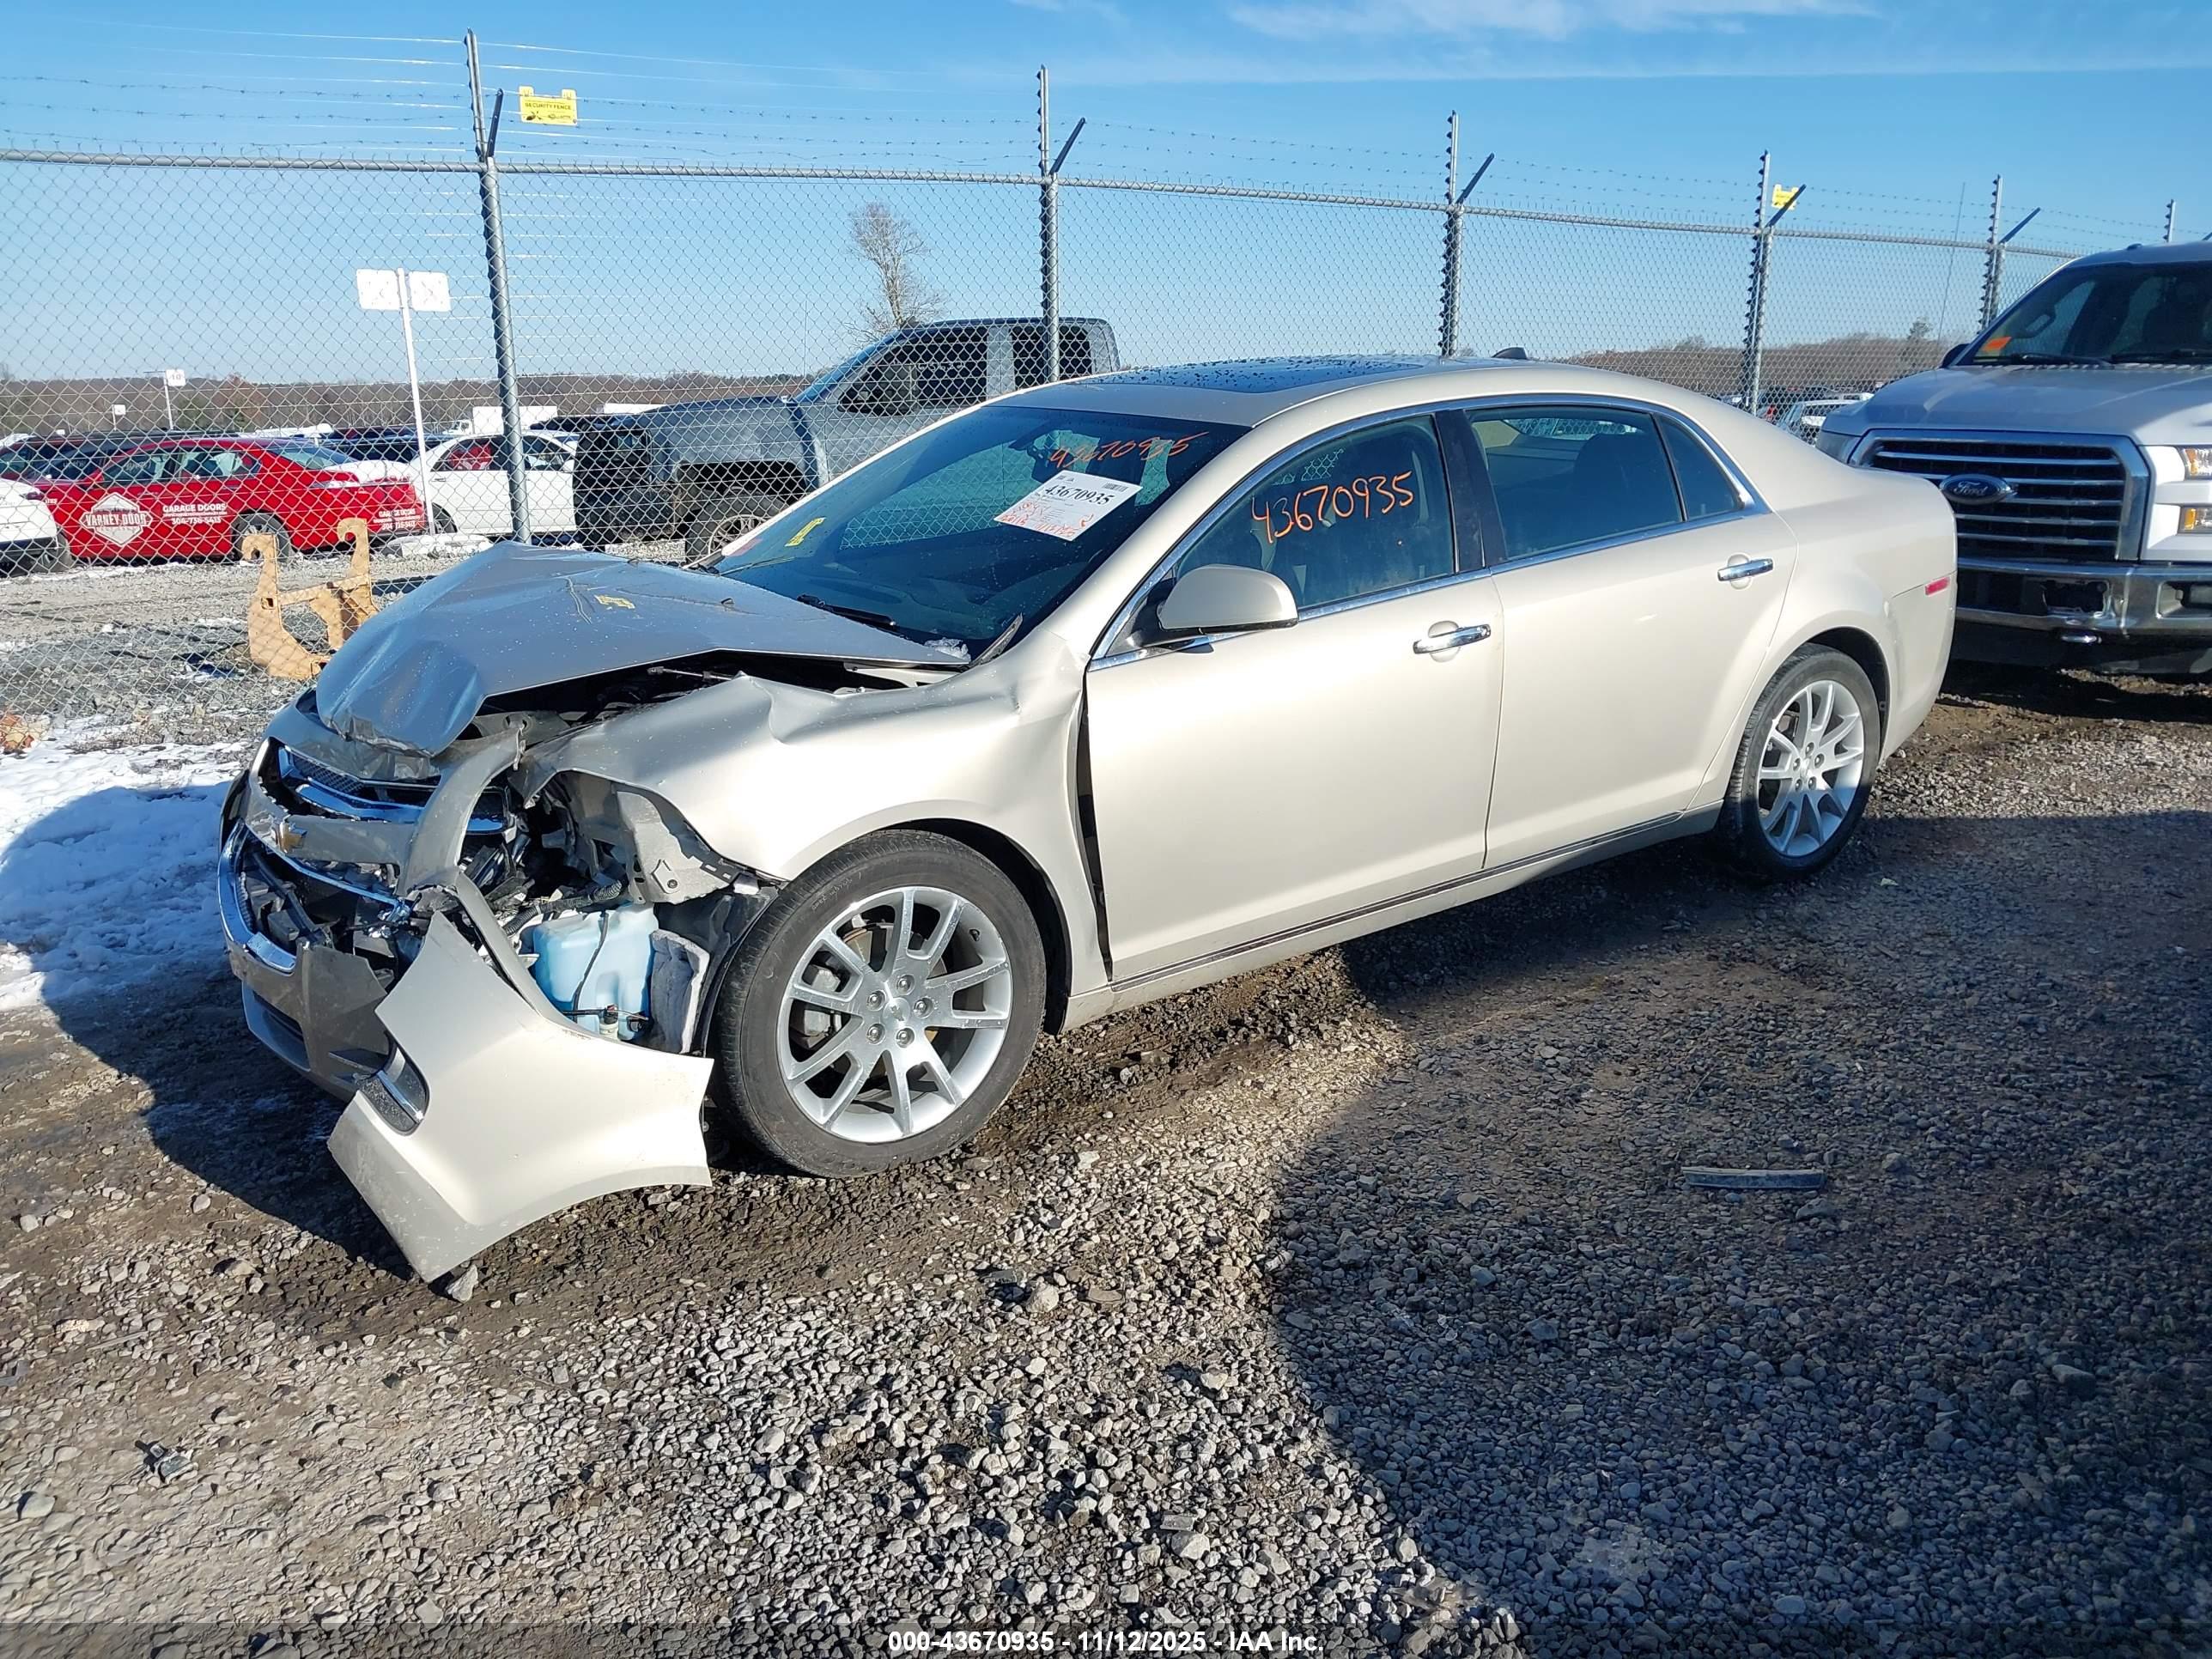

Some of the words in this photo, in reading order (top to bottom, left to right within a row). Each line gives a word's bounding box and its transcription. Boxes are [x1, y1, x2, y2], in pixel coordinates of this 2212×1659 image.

[1045, 484, 1115, 505] 43670935
[1953, 481, 1989, 495] Ford
[163, 504, 196, 513] GARAGE
[198, 502, 226, 512] DOORS
[1252, 471, 1414, 544] 43670935
[86, 514, 119, 526] VARNEY
